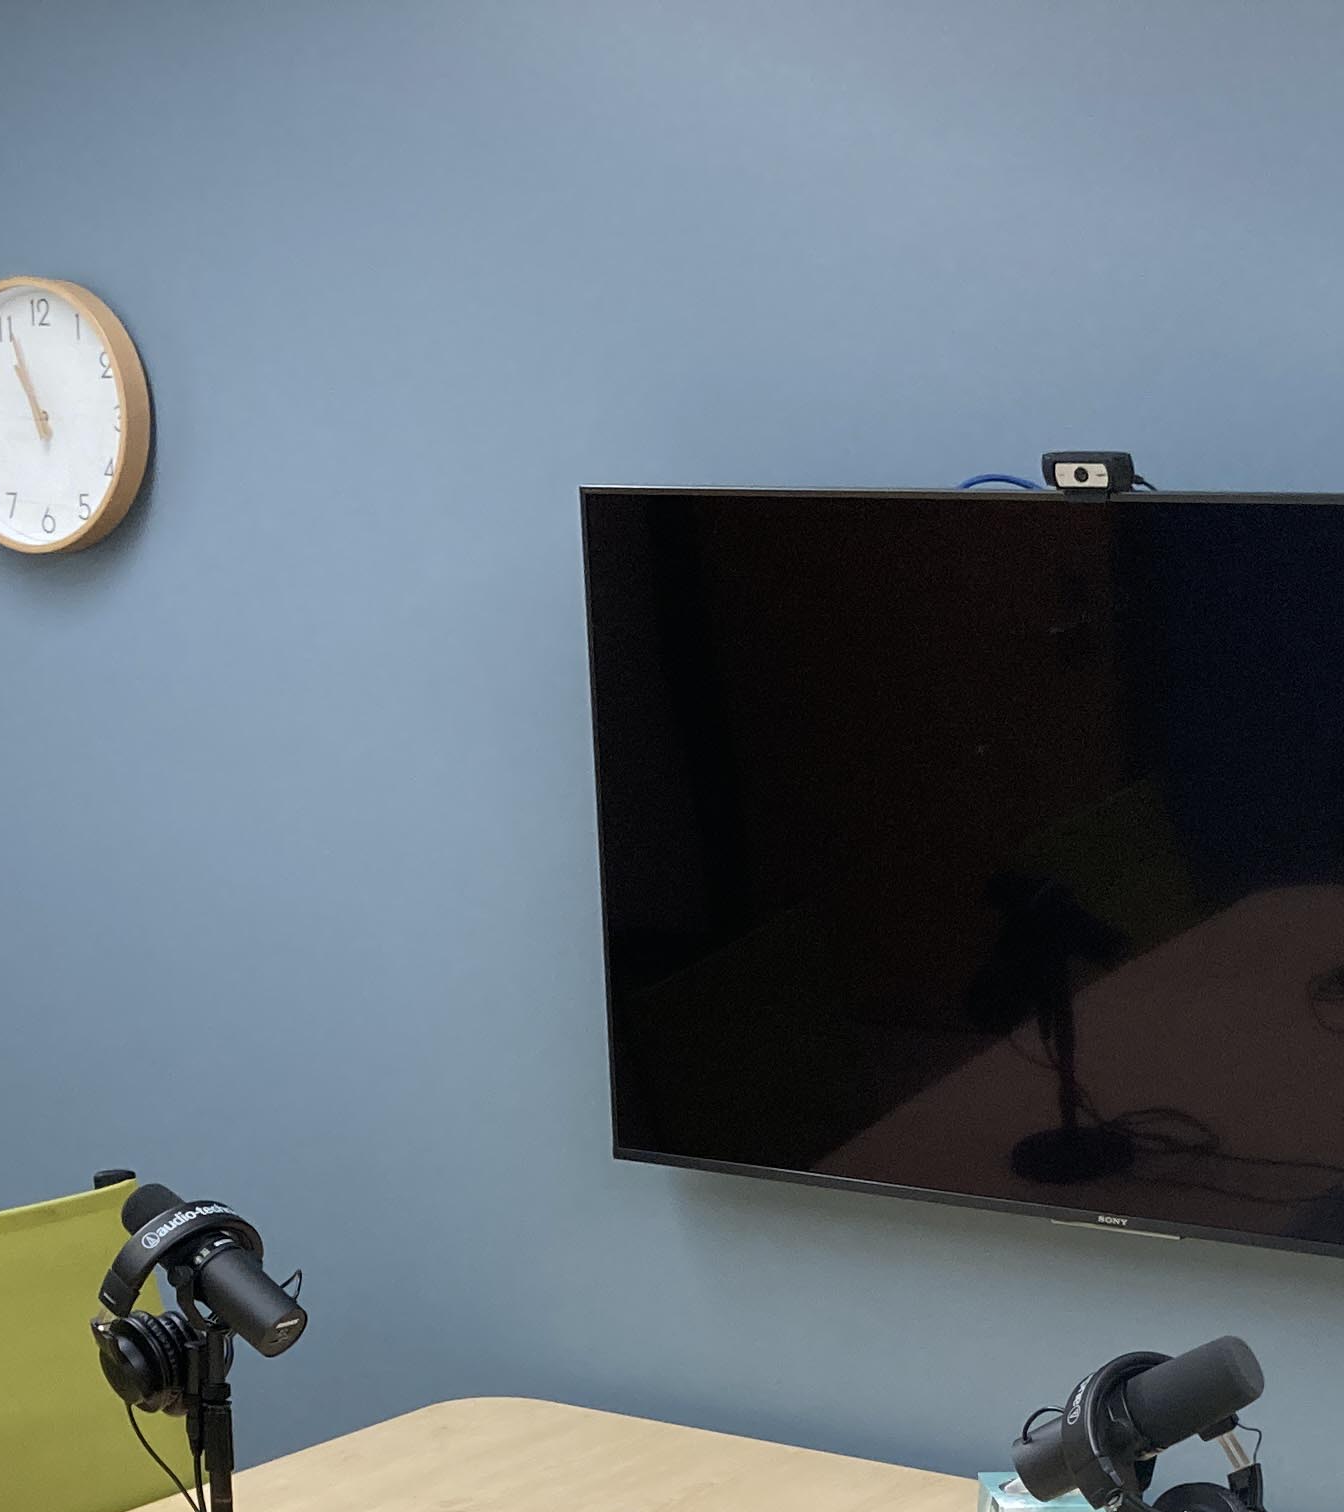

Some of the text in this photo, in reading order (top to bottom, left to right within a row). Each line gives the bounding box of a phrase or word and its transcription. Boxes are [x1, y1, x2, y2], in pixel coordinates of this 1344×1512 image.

[31, 298, 50, 326] 12
[75, 313, 80, 340] 1
[99, 351, 113, 378] 2
[6, 492, 17, 519] 7
[78, 493, 91, 520] 5
[42, 507, 56, 533] 6
[1098, 1215, 1127, 1226] SONY
